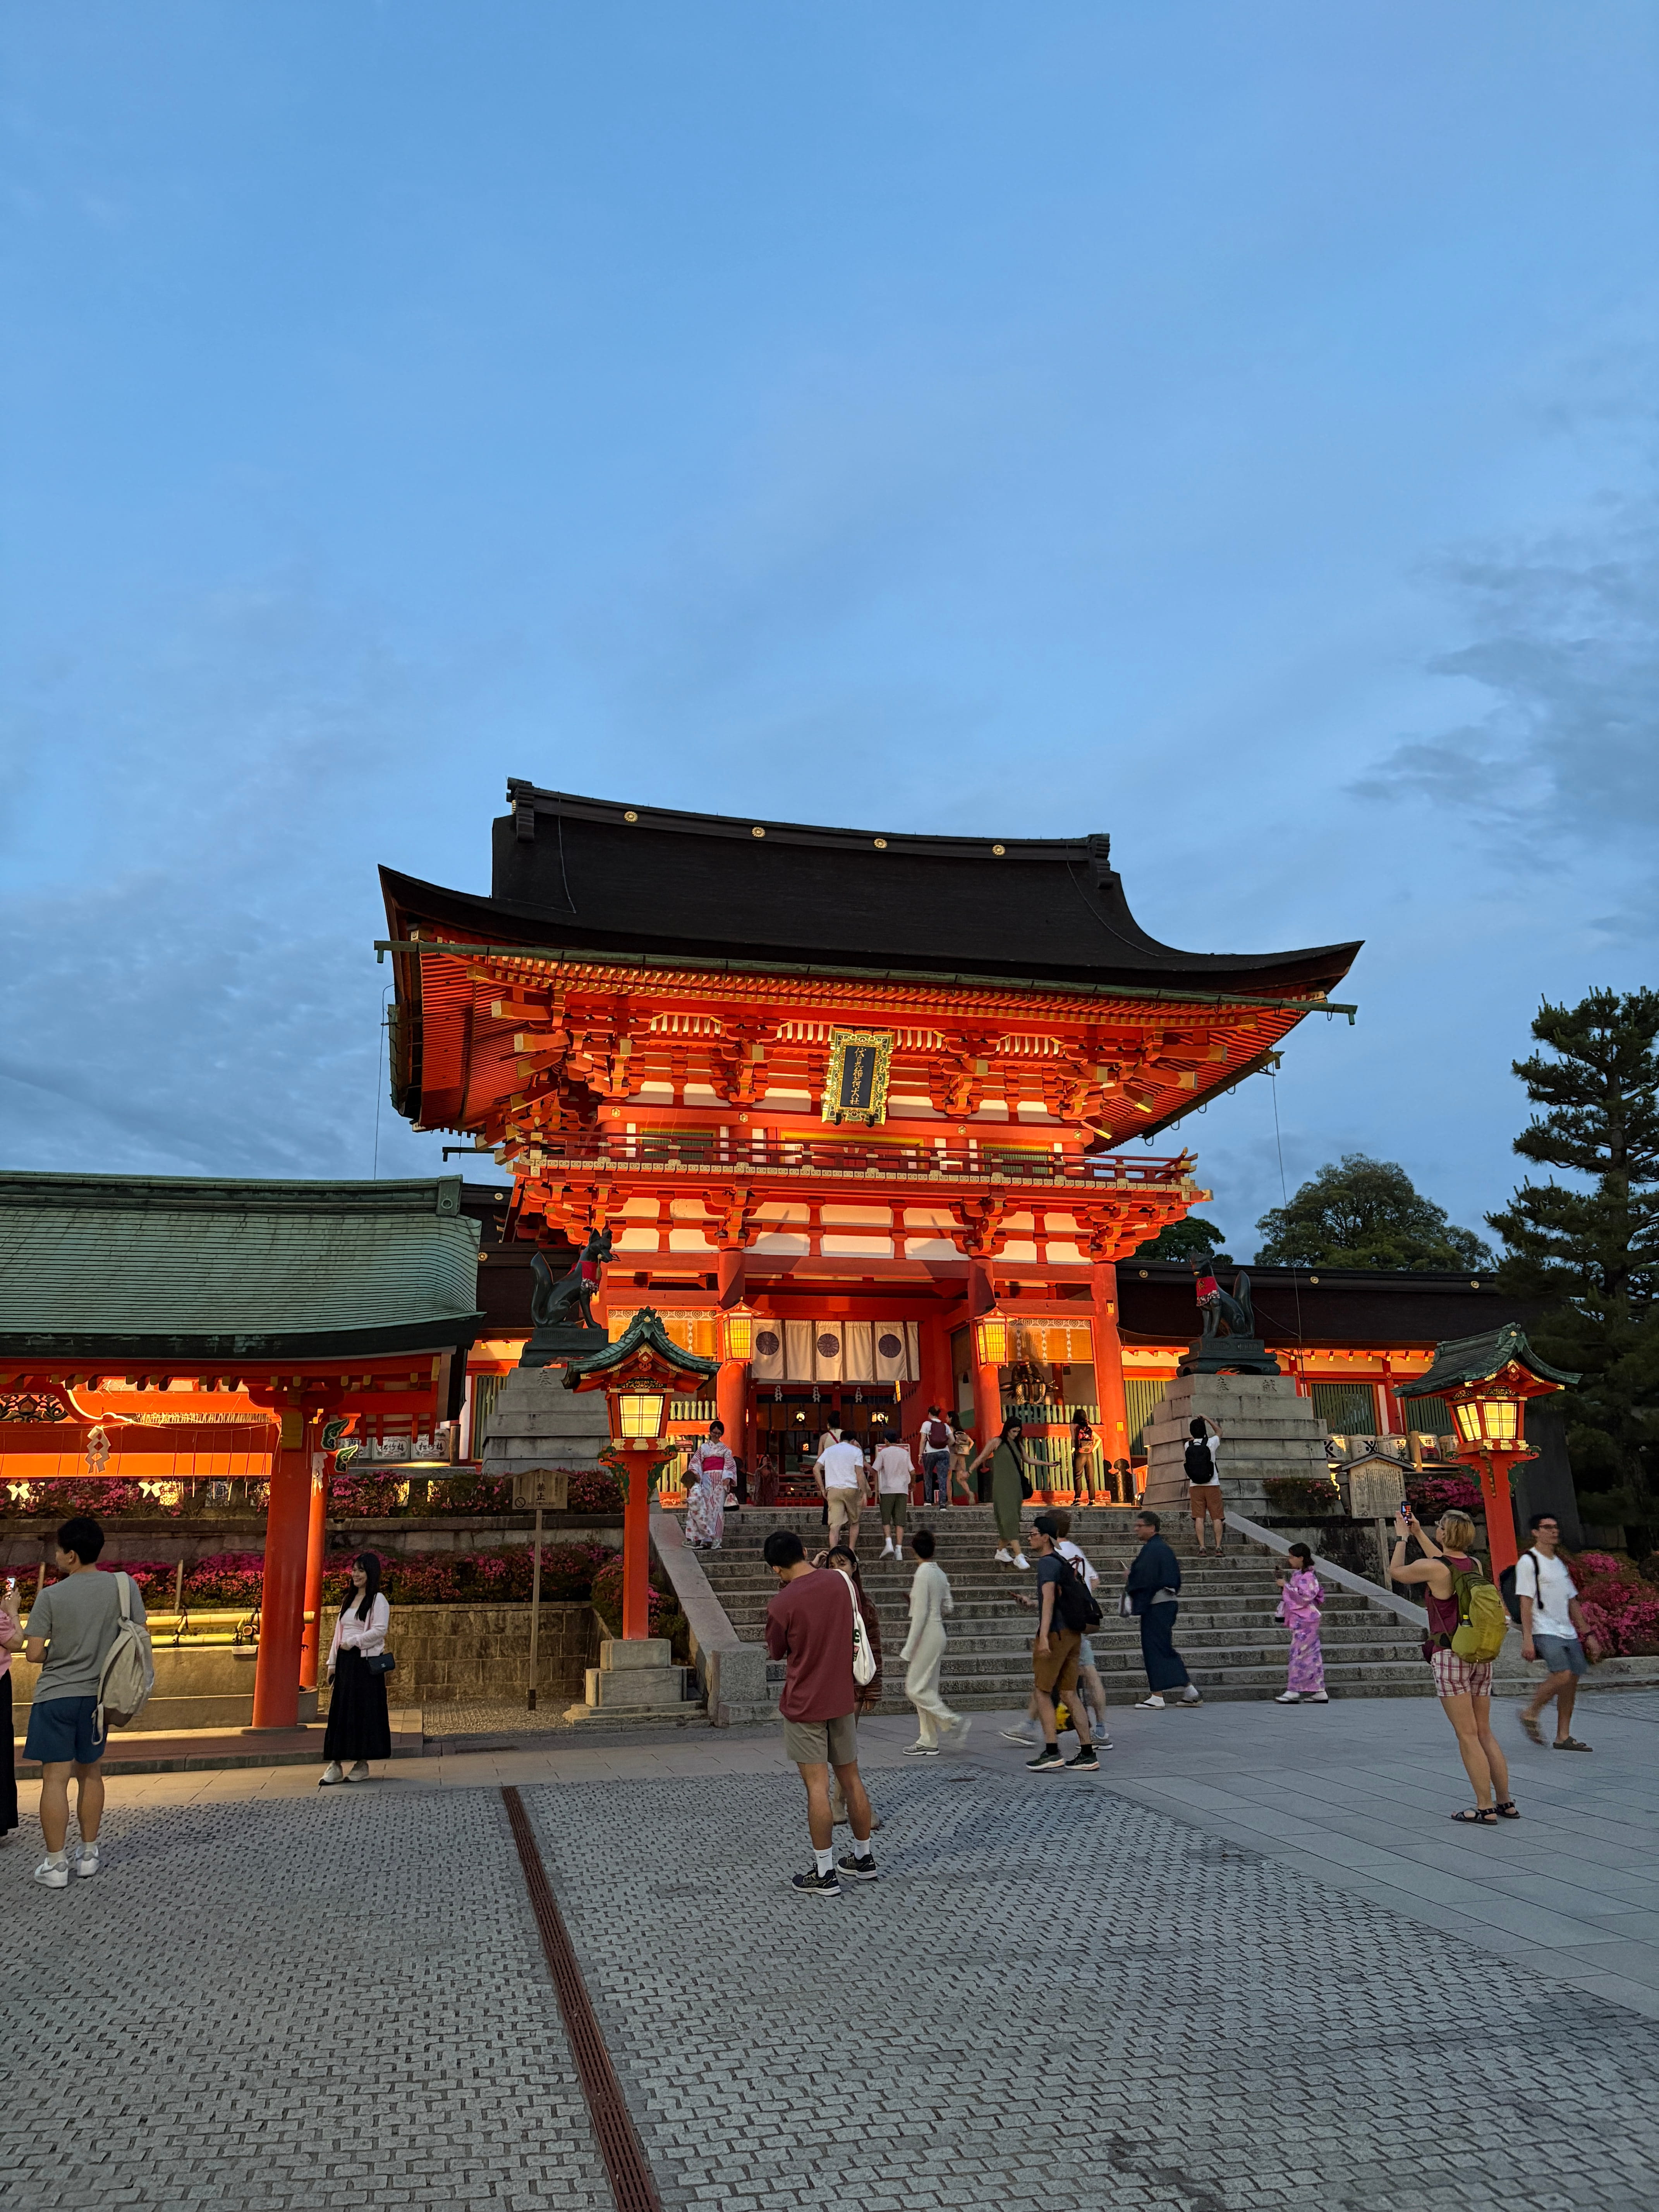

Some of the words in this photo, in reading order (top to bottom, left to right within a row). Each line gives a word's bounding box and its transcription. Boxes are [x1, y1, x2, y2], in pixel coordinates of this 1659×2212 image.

[850, 1047, 867, 1105] 伏見稲荷大社
